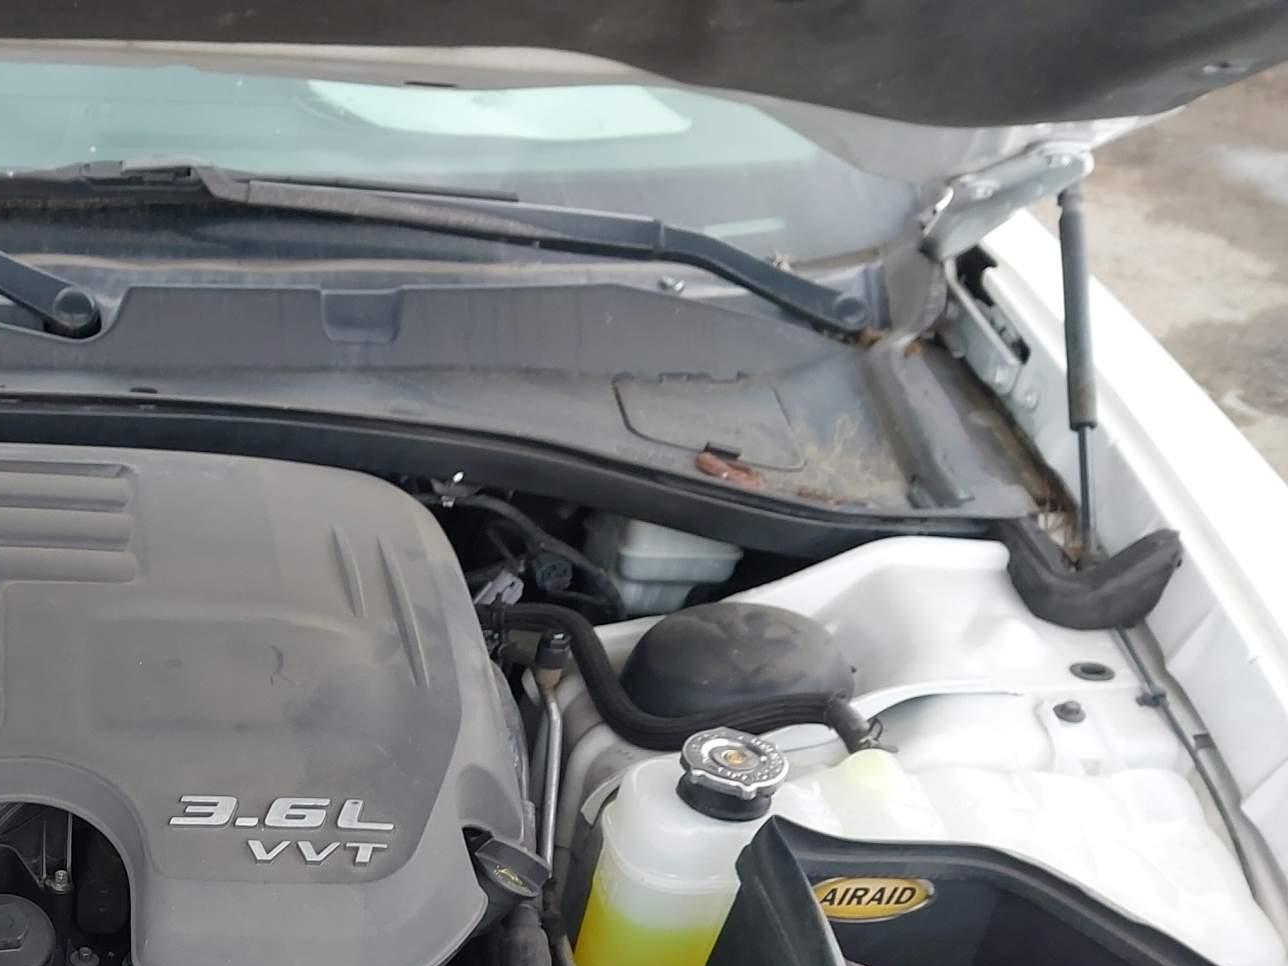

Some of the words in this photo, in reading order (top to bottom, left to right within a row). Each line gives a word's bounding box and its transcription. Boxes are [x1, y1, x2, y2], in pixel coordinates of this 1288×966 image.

[168, 795, 395, 830] 3.6L
[247, 839, 389, 865] VVT
[819, 886, 917, 906] AIRAID
